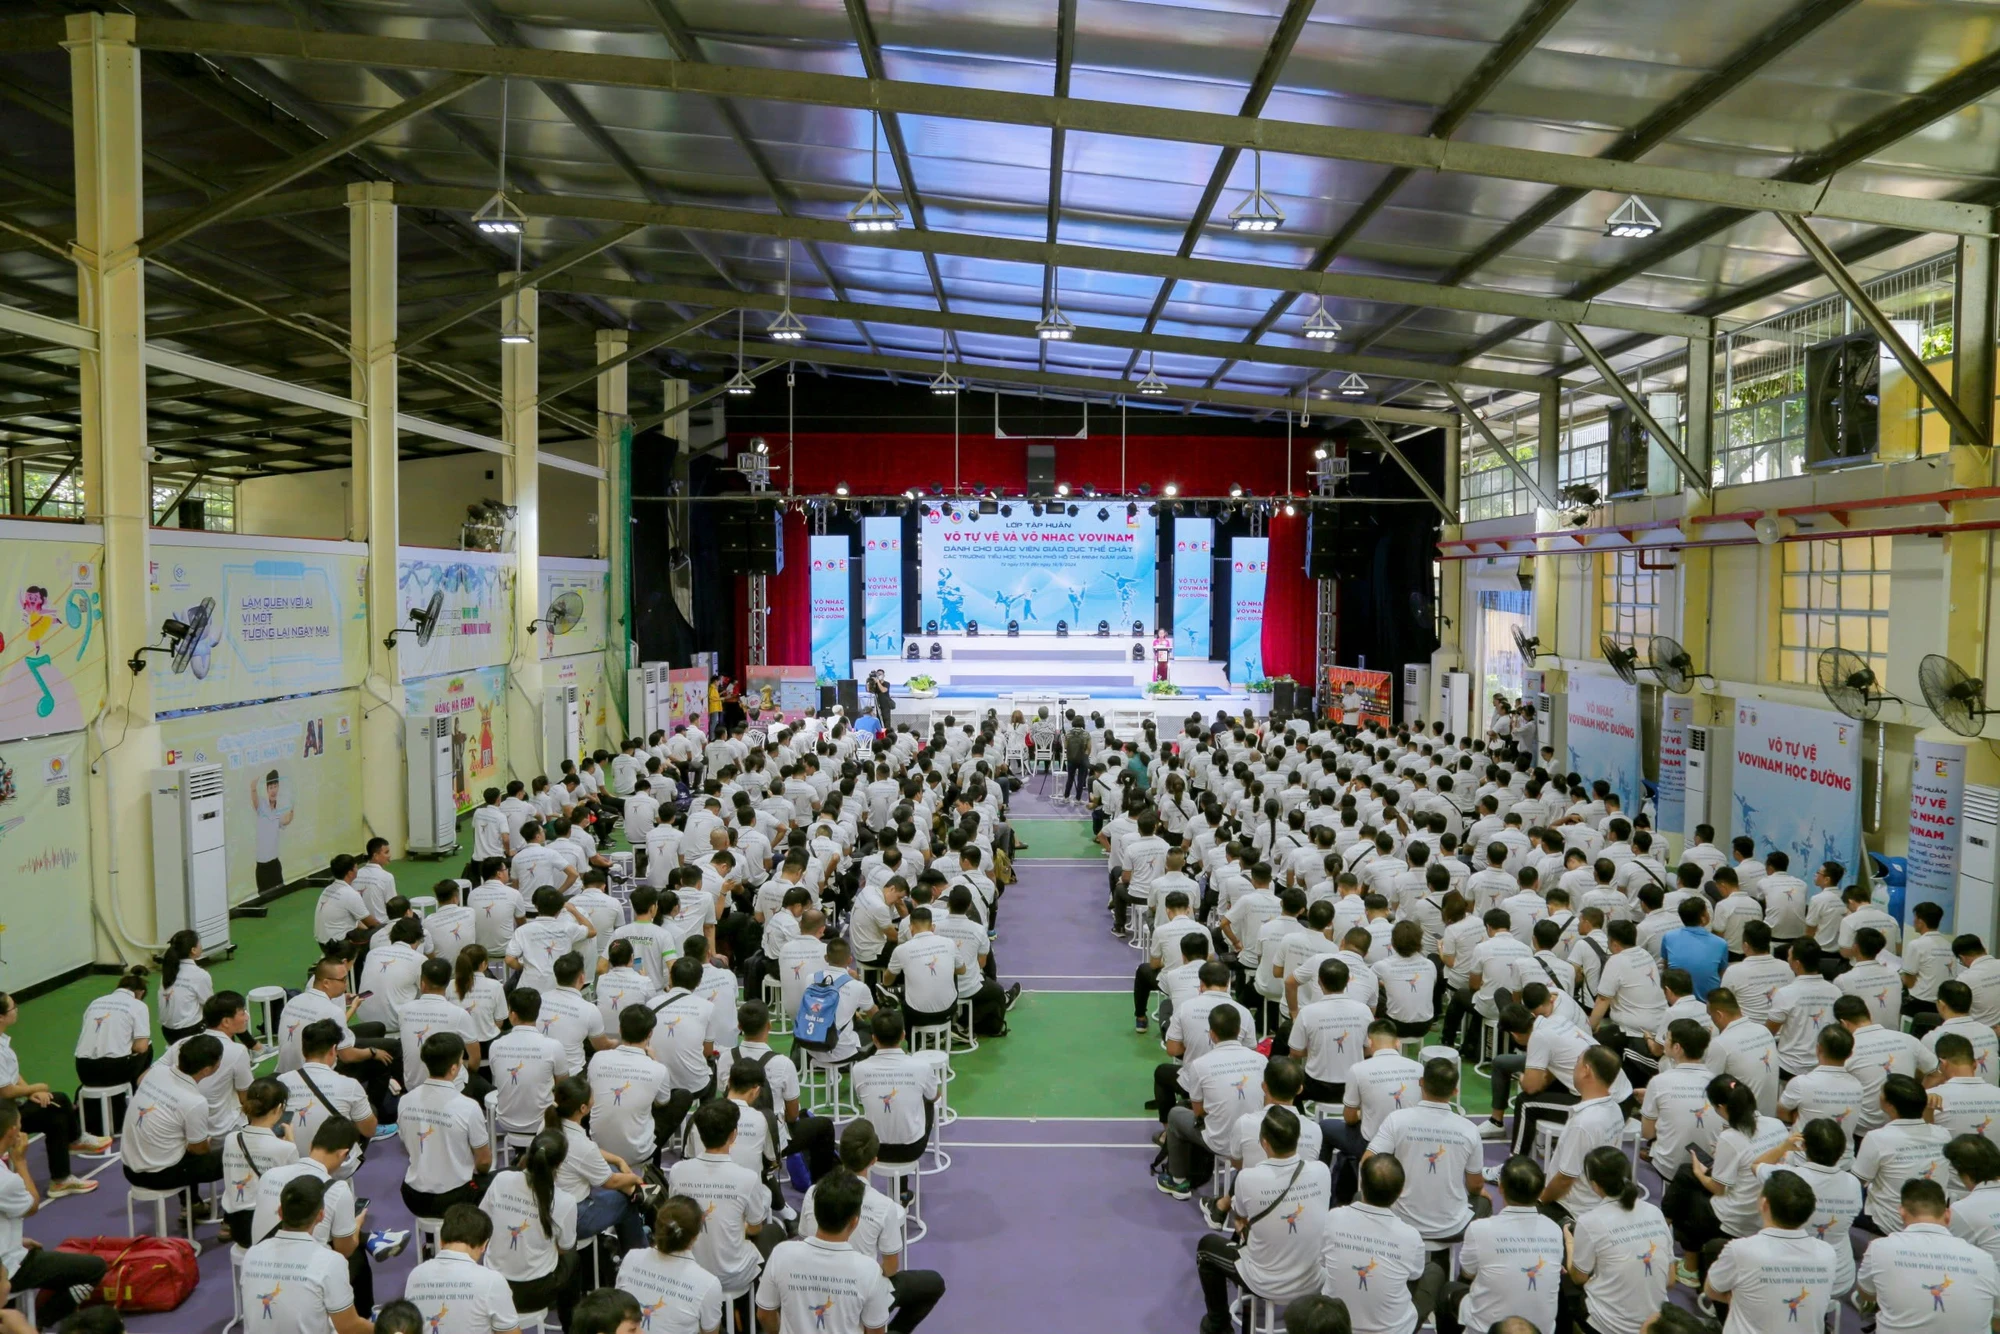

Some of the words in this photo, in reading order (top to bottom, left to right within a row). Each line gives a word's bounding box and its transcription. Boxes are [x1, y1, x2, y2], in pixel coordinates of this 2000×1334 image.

[944, 531, 961, 541] VÕ
[964, 531, 981, 543] TỰ
[984, 531, 999, 543] VỆ
[1003, 531, 1018, 541] VÀ
[1021, 531, 1038, 541] VÕ
[1042, 533, 1075, 543] NHẠC
[1078, 533, 1134, 542] VOVINAM
[242, 595, 261, 607] LÀM
[264, 597, 288, 608] QUEN
[290, 595, 303, 607] VỚI
[305, 597, 313, 606] AI
[277, 628, 290, 637] LAI
[316, 625, 329, 635] MAI
[461, 696, 475, 710] FARM
[1586, 701, 1595, 714] VÕ
[1596, 704, 1614, 719] NHẠC
[1568, 713, 1596, 729] VOVINAM
[1596, 719, 1609, 734] HỌC
[1610, 722, 1635, 739] ĐƯỜNG
[304, 718, 324, 758] AI
[1768, 736, 1783, 753] VÕ
[1785, 741, 1800, 760] TỰ
[1802, 744, 1817, 764] VỆ
[1738, 751, 1783, 774] VOVINAM
[1785, 762, 1807, 781] HỌC
[1810, 769, 1851, 791] ĐƯỜNG
[1929, 797, 1947, 811] VỆ
[1920, 813, 1956, 827] NHẠC
[806, 1022, 815, 1035] 3
